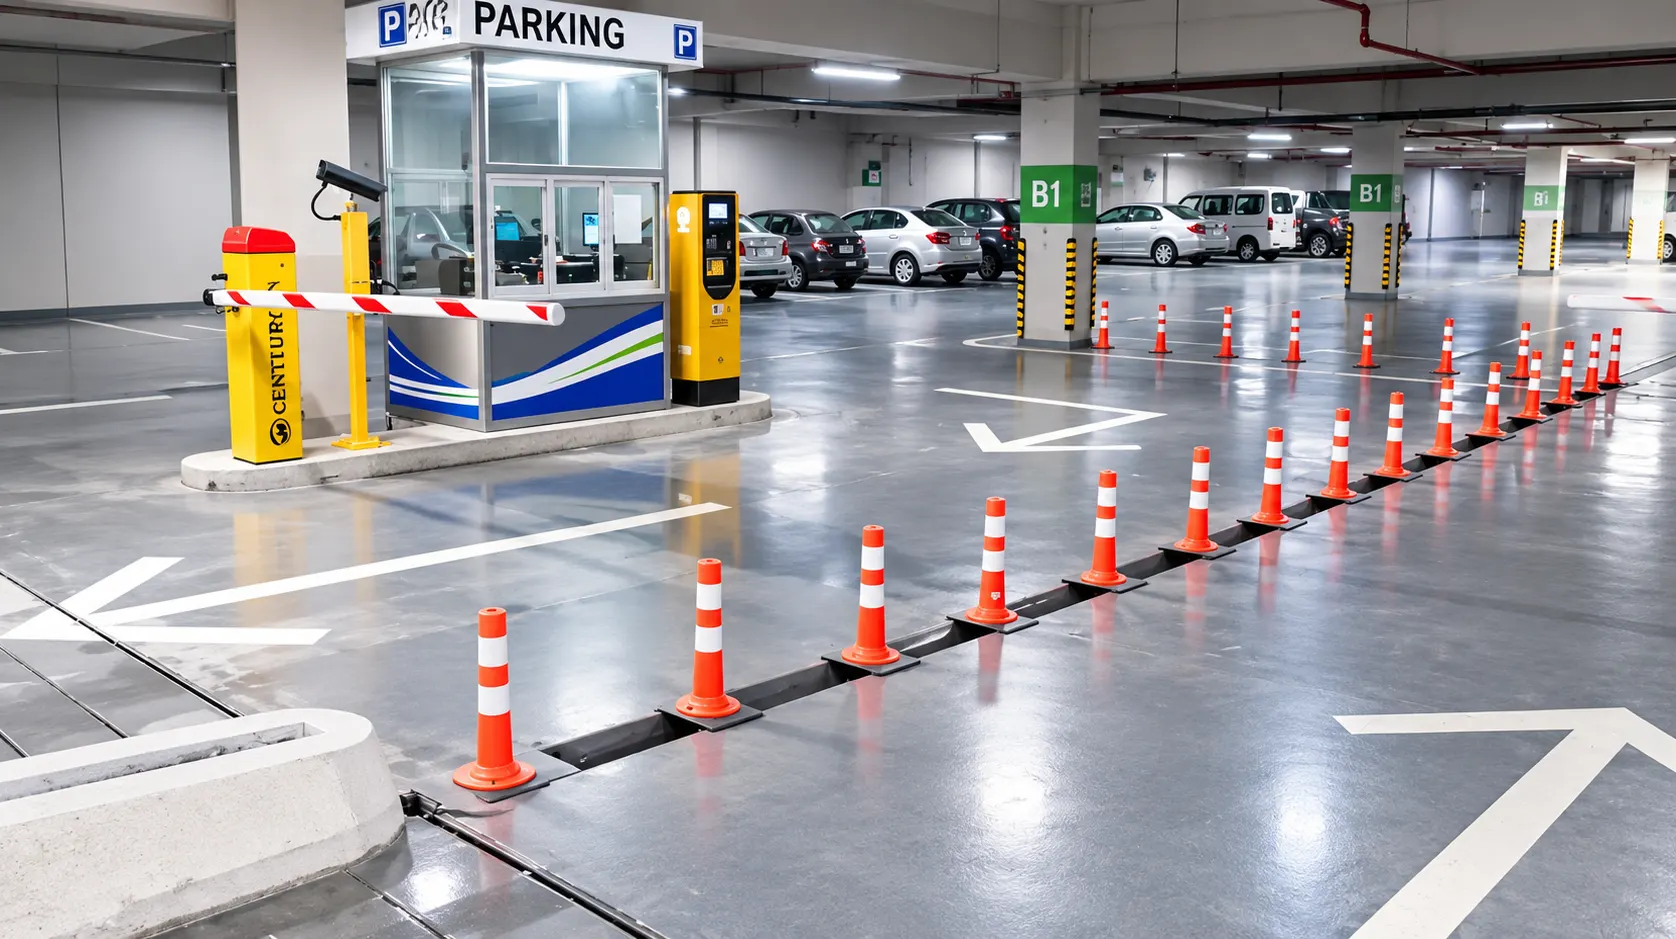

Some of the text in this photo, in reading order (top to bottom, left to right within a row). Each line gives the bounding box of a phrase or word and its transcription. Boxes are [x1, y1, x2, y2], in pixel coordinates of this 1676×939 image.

[384, 10, 401, 42] P
[474, 0, 625, 50] PARKING
[678, 29, 693, 55] P
[1031, 180, 1060, 208] B1
[1360, 183, 1382, 203] B1
